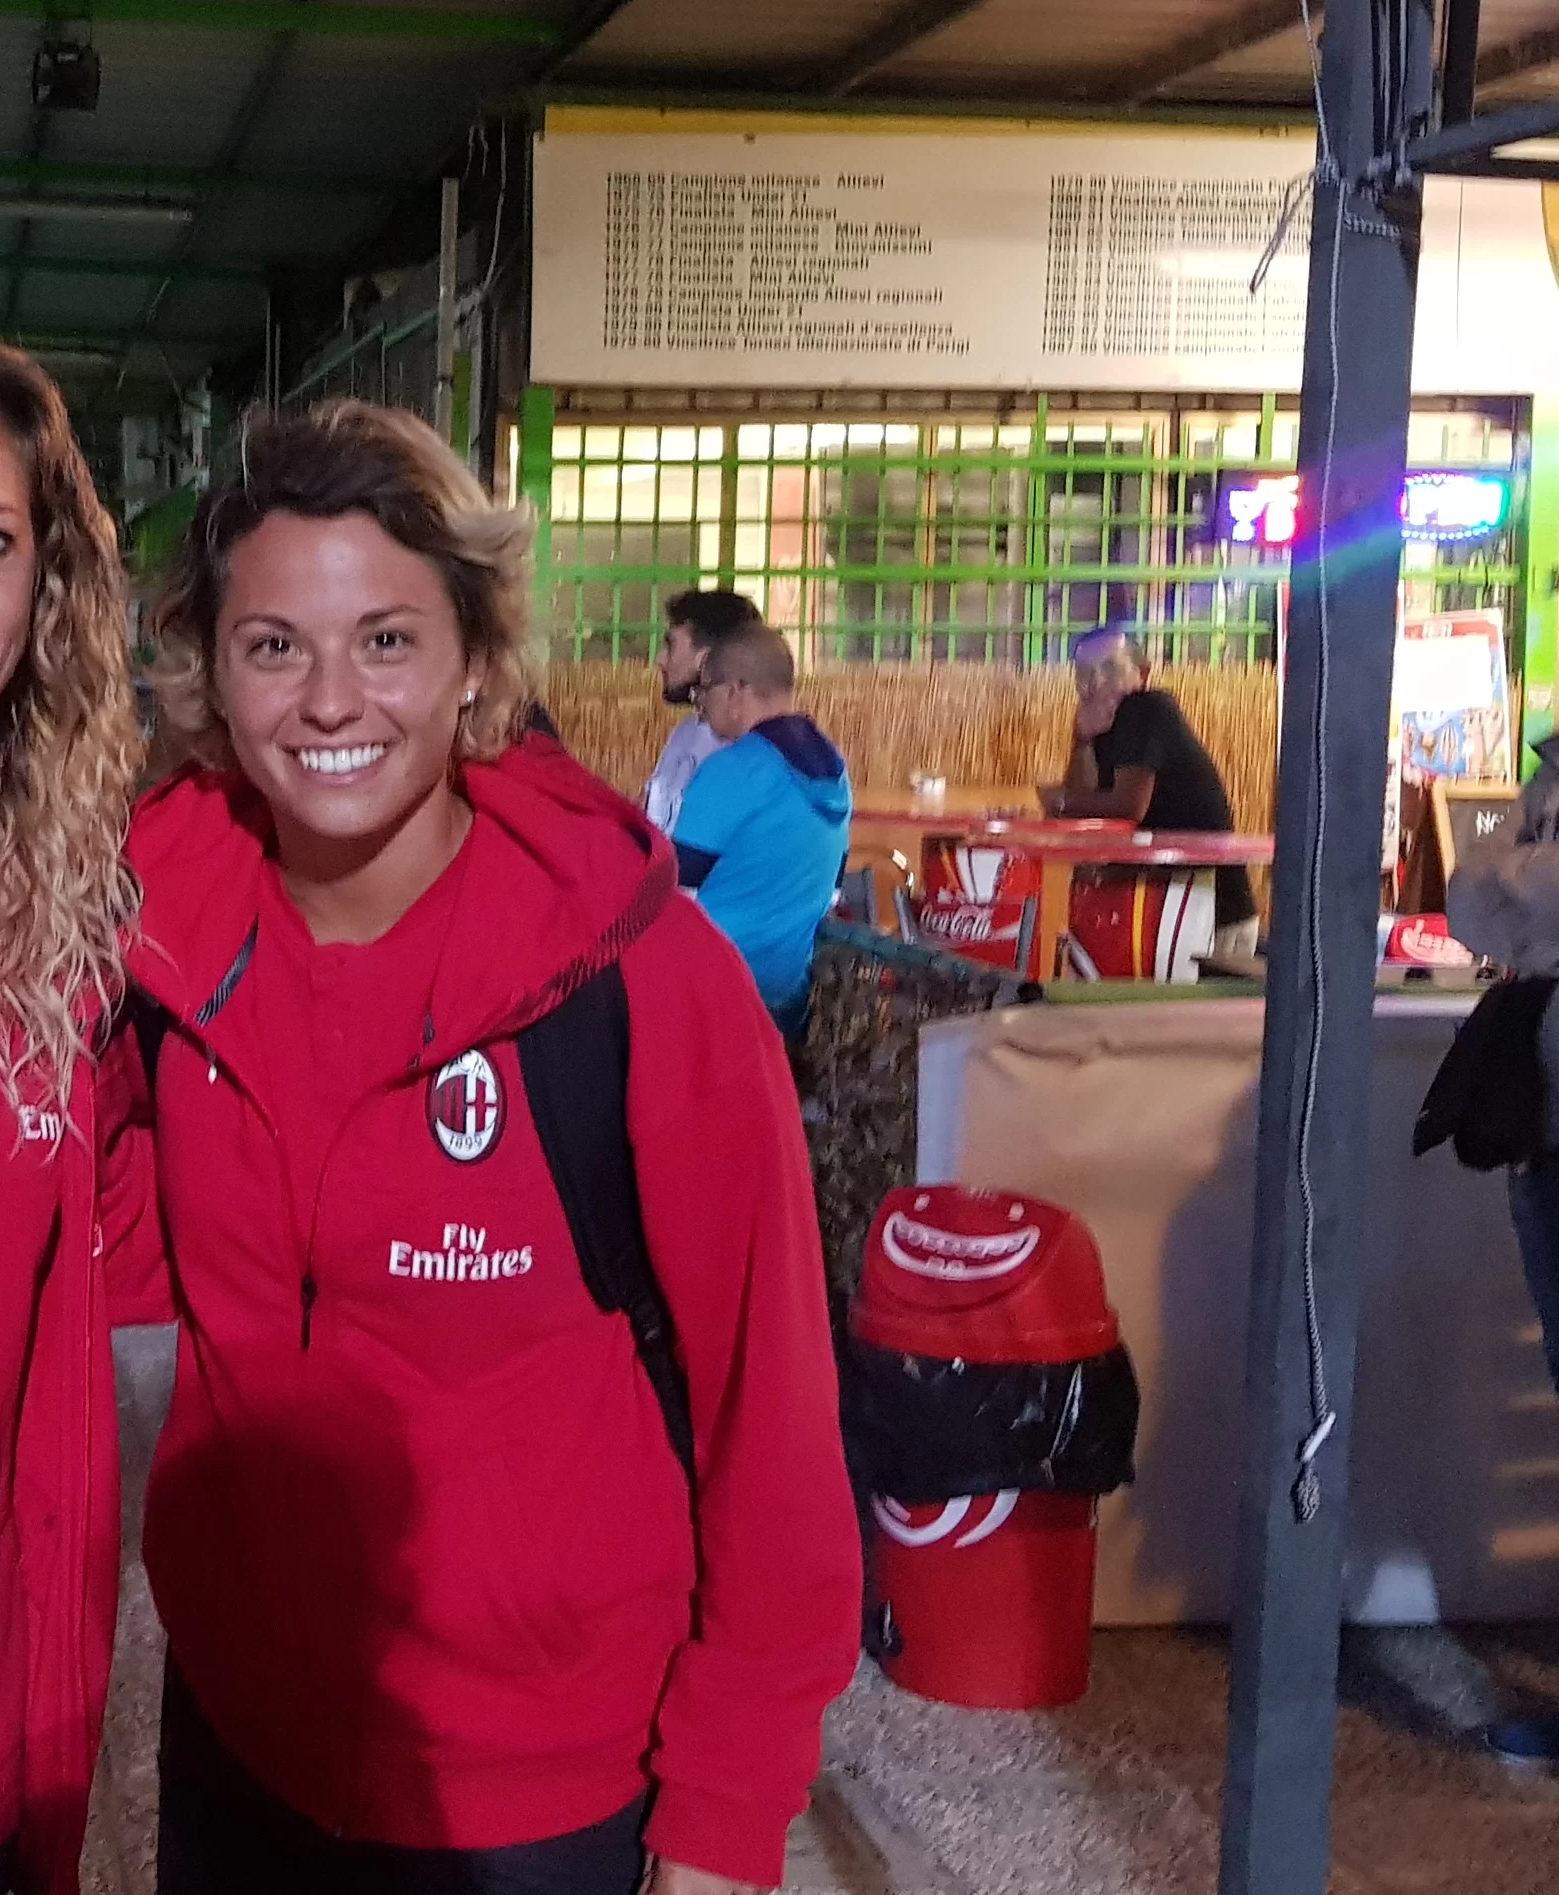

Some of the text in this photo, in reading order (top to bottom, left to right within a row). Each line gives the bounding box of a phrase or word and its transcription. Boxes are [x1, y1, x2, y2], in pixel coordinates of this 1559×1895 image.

[448, 1133, 483, 1150] 1899
[442, 1223, 486, 1253] Fly
[388, 1240, 533, 1282] Emirates
